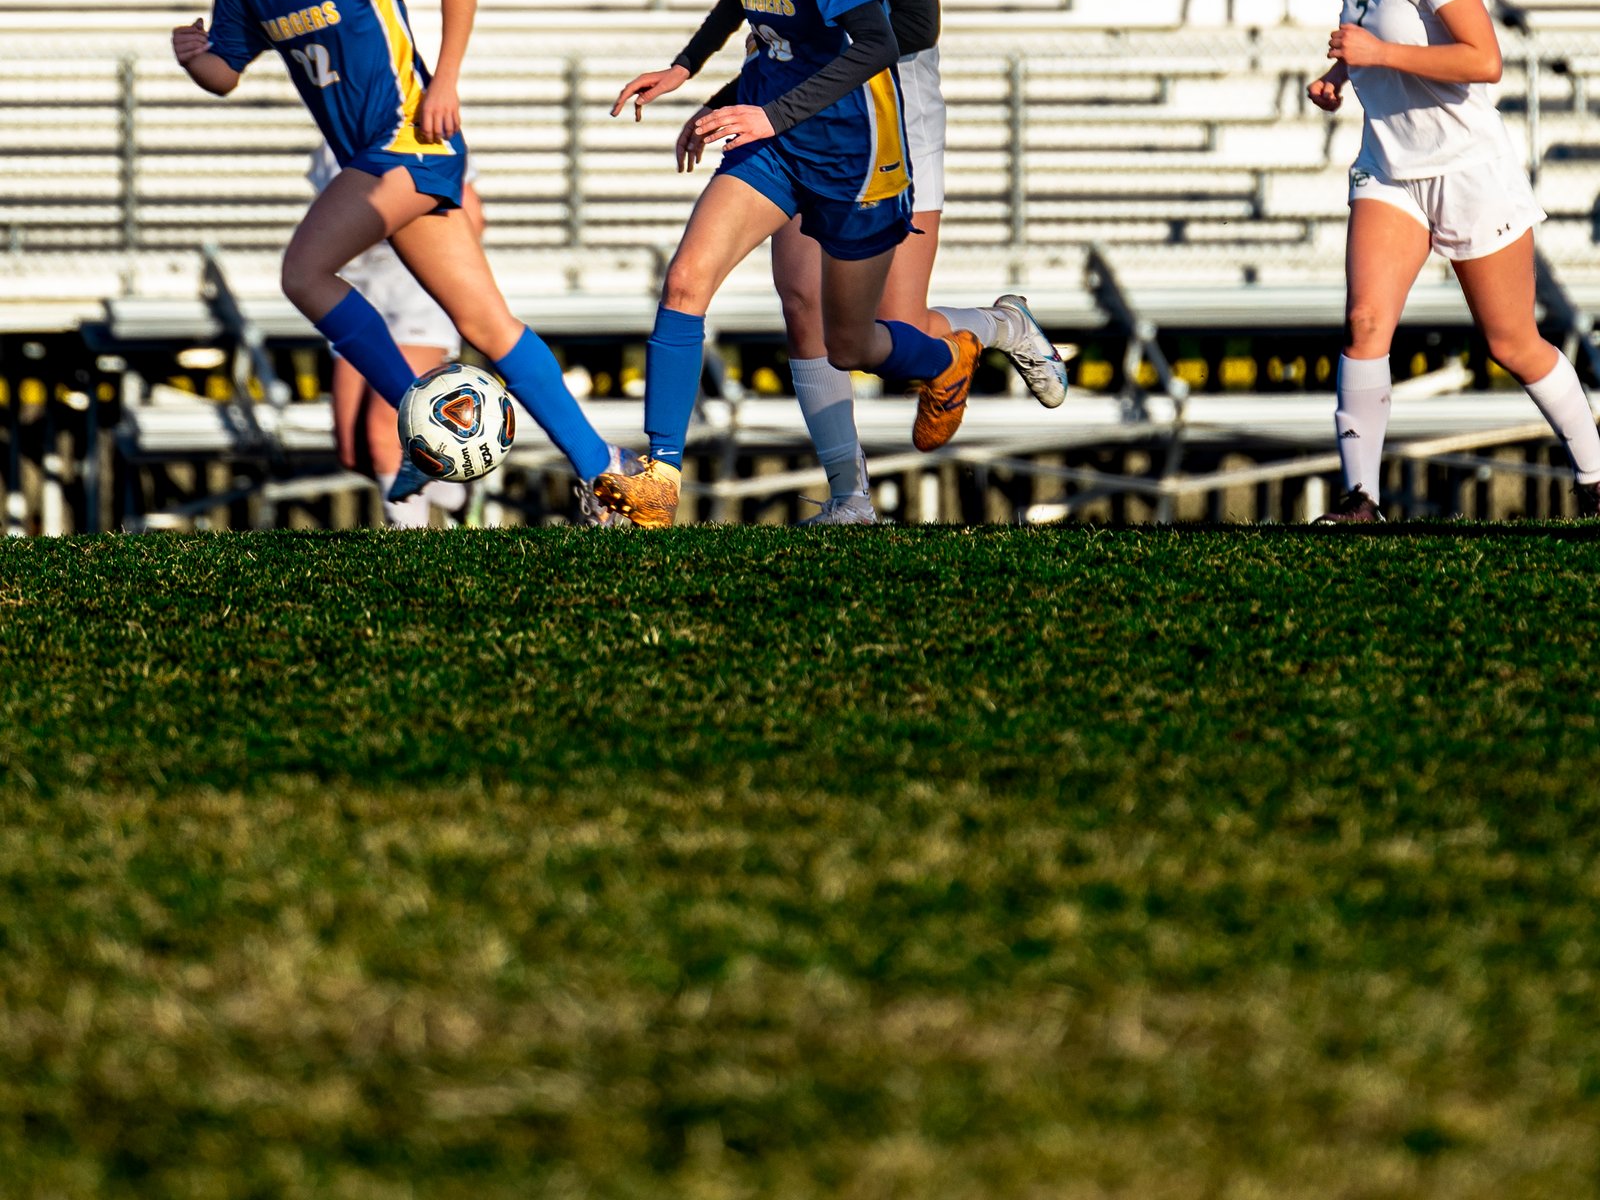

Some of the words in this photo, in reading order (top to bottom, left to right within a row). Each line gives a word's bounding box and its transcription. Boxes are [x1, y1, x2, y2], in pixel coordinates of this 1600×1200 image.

[260, 0, 342, 42] ARGERS
[1356, 0, 1369, 27] 7
[461, 446, 475, 478] Wilson
[479, 442, 494, 469] NCAA
